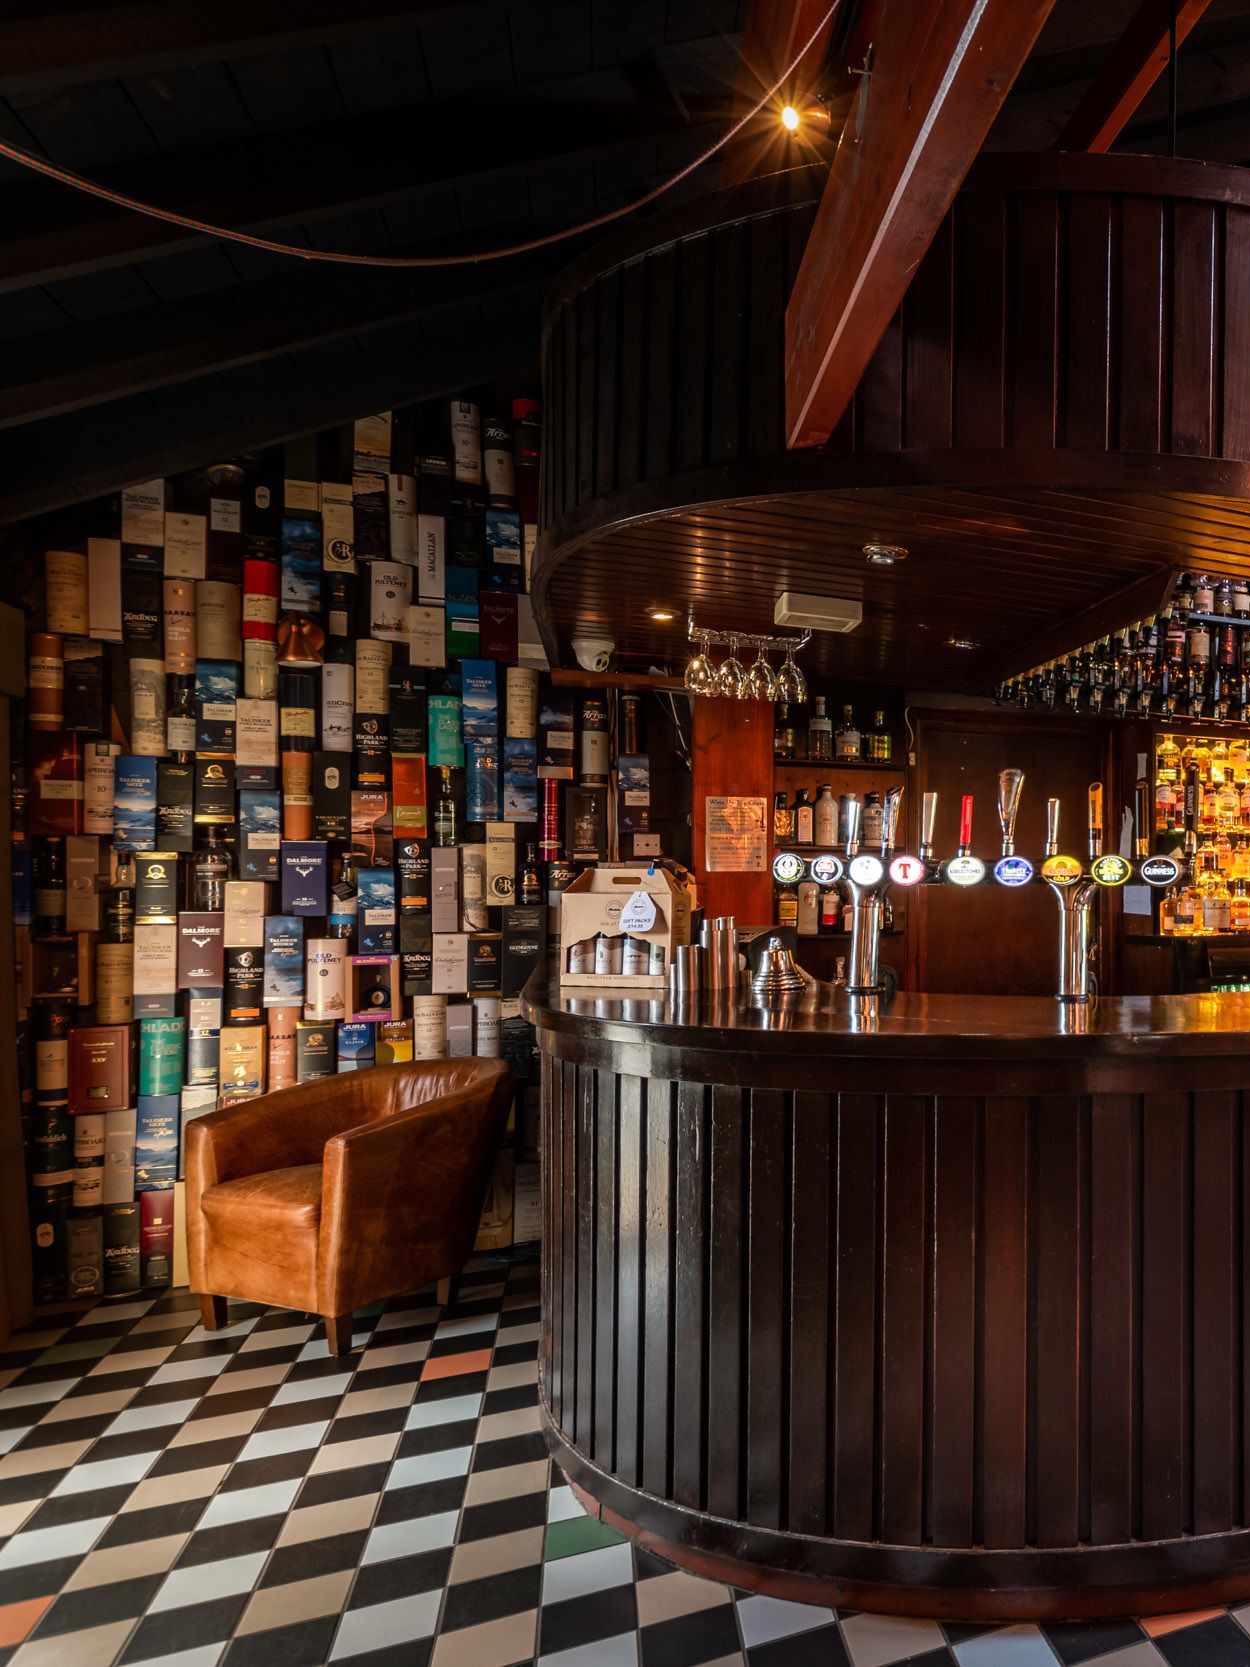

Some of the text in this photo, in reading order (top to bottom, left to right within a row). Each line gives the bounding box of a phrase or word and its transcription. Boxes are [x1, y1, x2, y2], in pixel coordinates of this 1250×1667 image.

[375, 579, 407, 587] PULTENEY
[899, 863, 911, 878] T
[1144, 866, 1175, 875] GUINNESS
